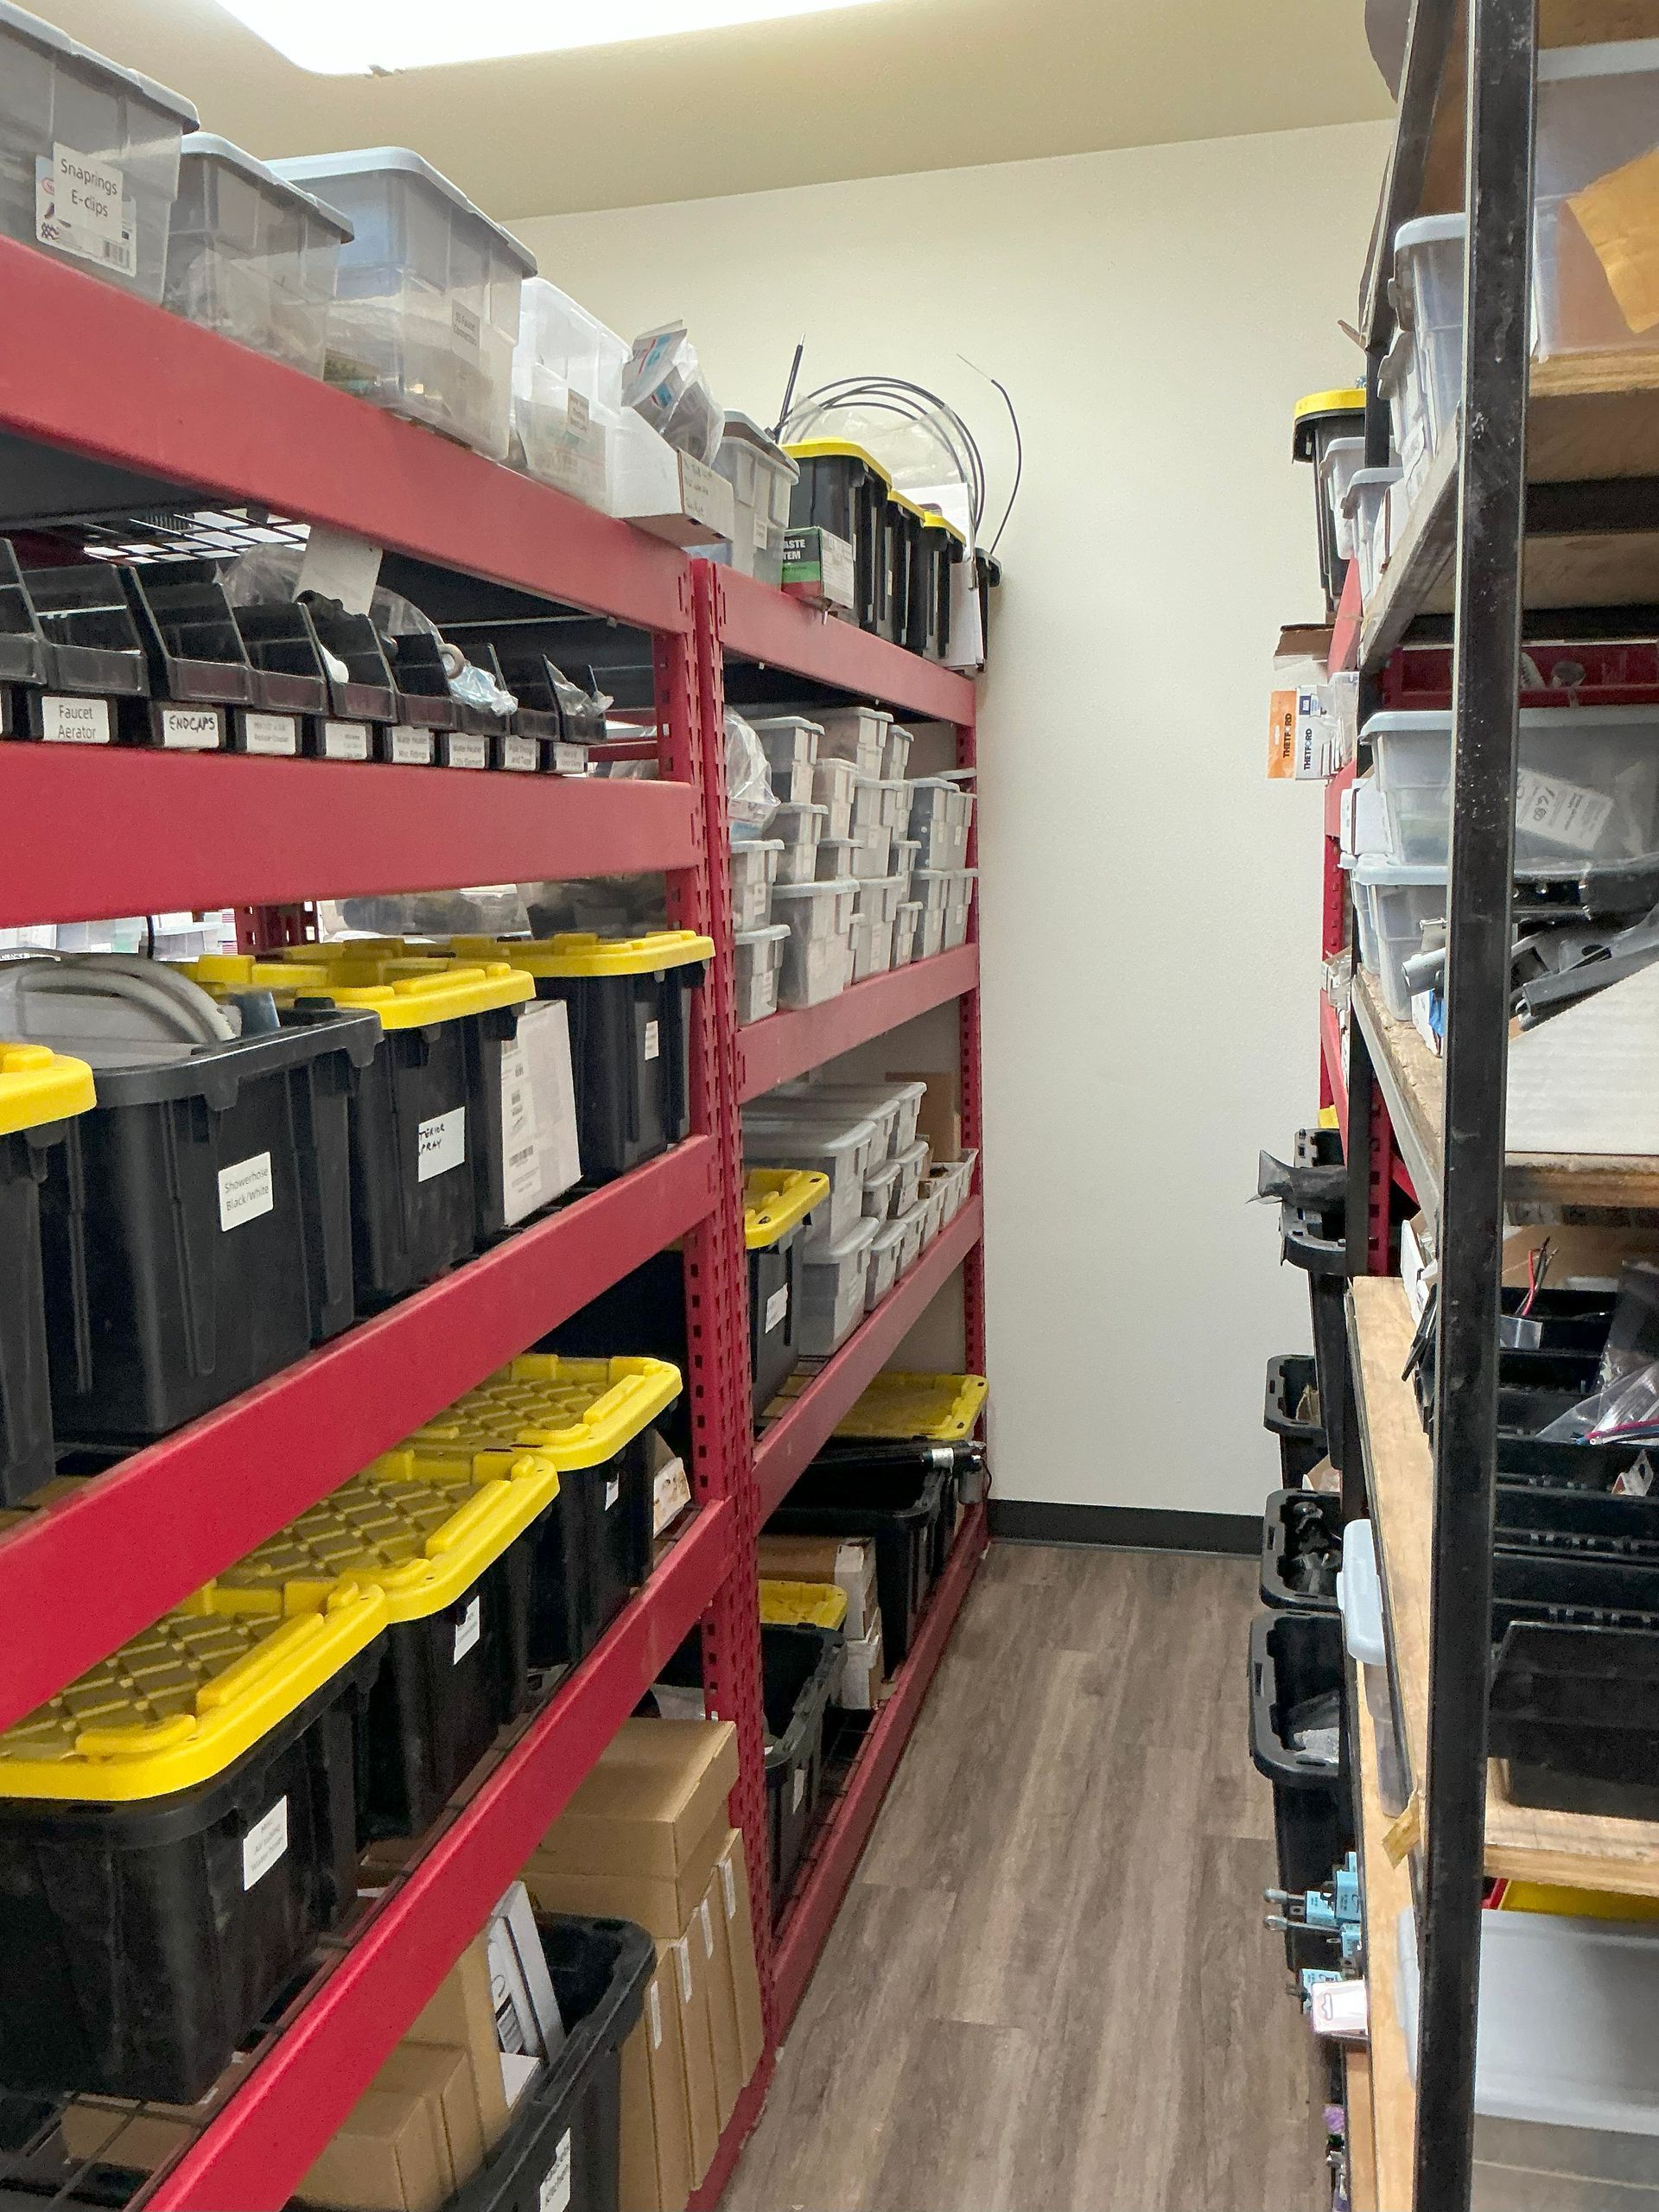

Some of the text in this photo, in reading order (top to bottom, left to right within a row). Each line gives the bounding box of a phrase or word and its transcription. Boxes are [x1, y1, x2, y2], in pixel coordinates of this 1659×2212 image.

[60, 157, 118, 196] Snaprings
[71, 188, 109, 218] E-clips
[59, 704, 93, 720] Faucet
[168, 715, 216, 734] ENDCAPS
[58, 724, 97, 740] Aerator
[1282, 713, 1293, 759] THETFORD
[1303, 728, 1313, 771] THETFORD
[419, 1139, 442, 1157] PRAY
[224, 1168, 269, 1193] Showerhose
[226, 1185, 270, 1211] Black/White
